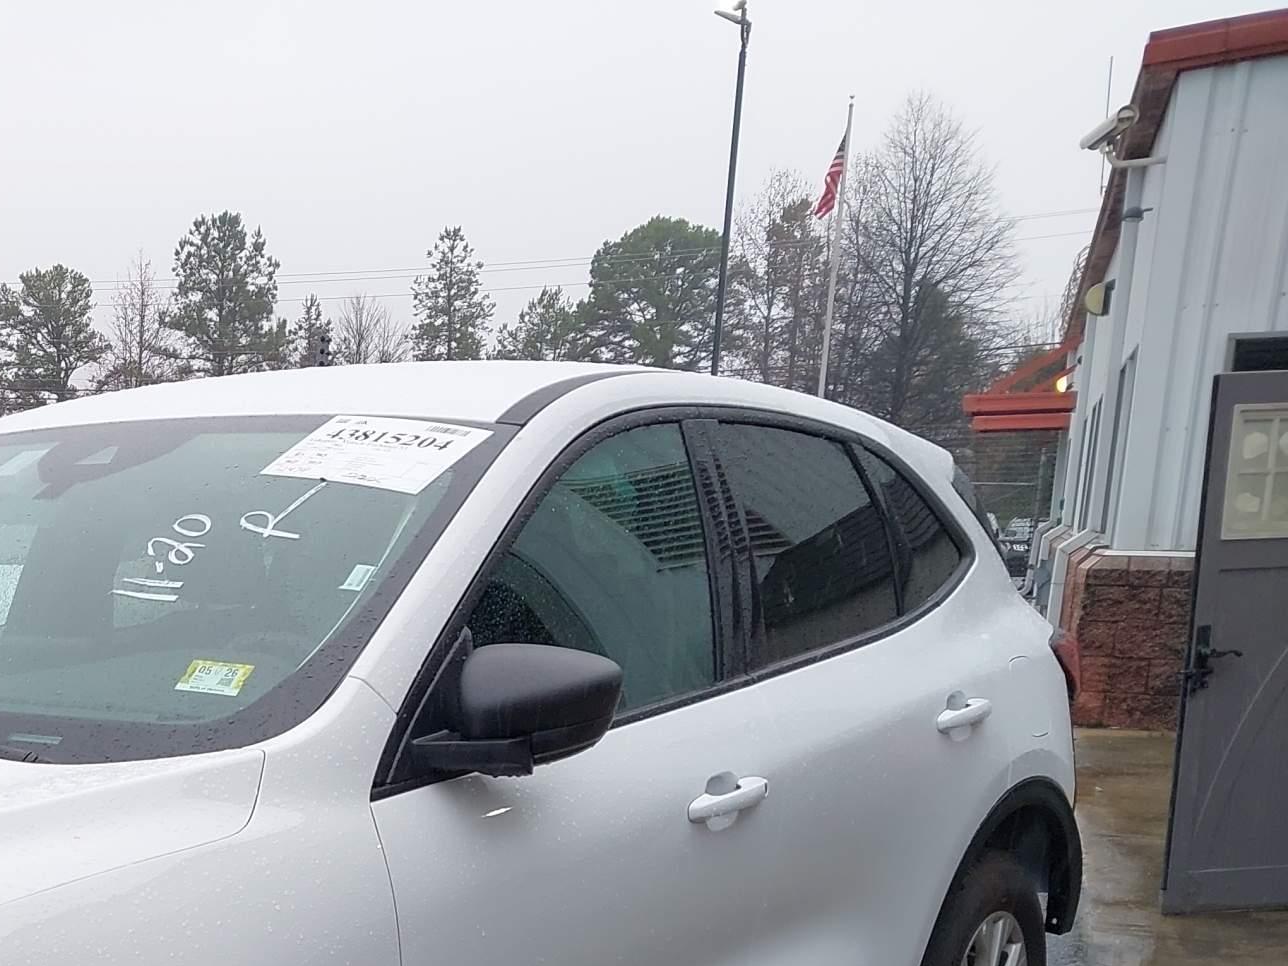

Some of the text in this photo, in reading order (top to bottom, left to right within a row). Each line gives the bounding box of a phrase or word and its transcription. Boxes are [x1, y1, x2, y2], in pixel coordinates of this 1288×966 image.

[326, 427, 454, 451] 43815204
[109, 513, 212, 602] 11-20
[198, 665, 239, 678] 05 26
